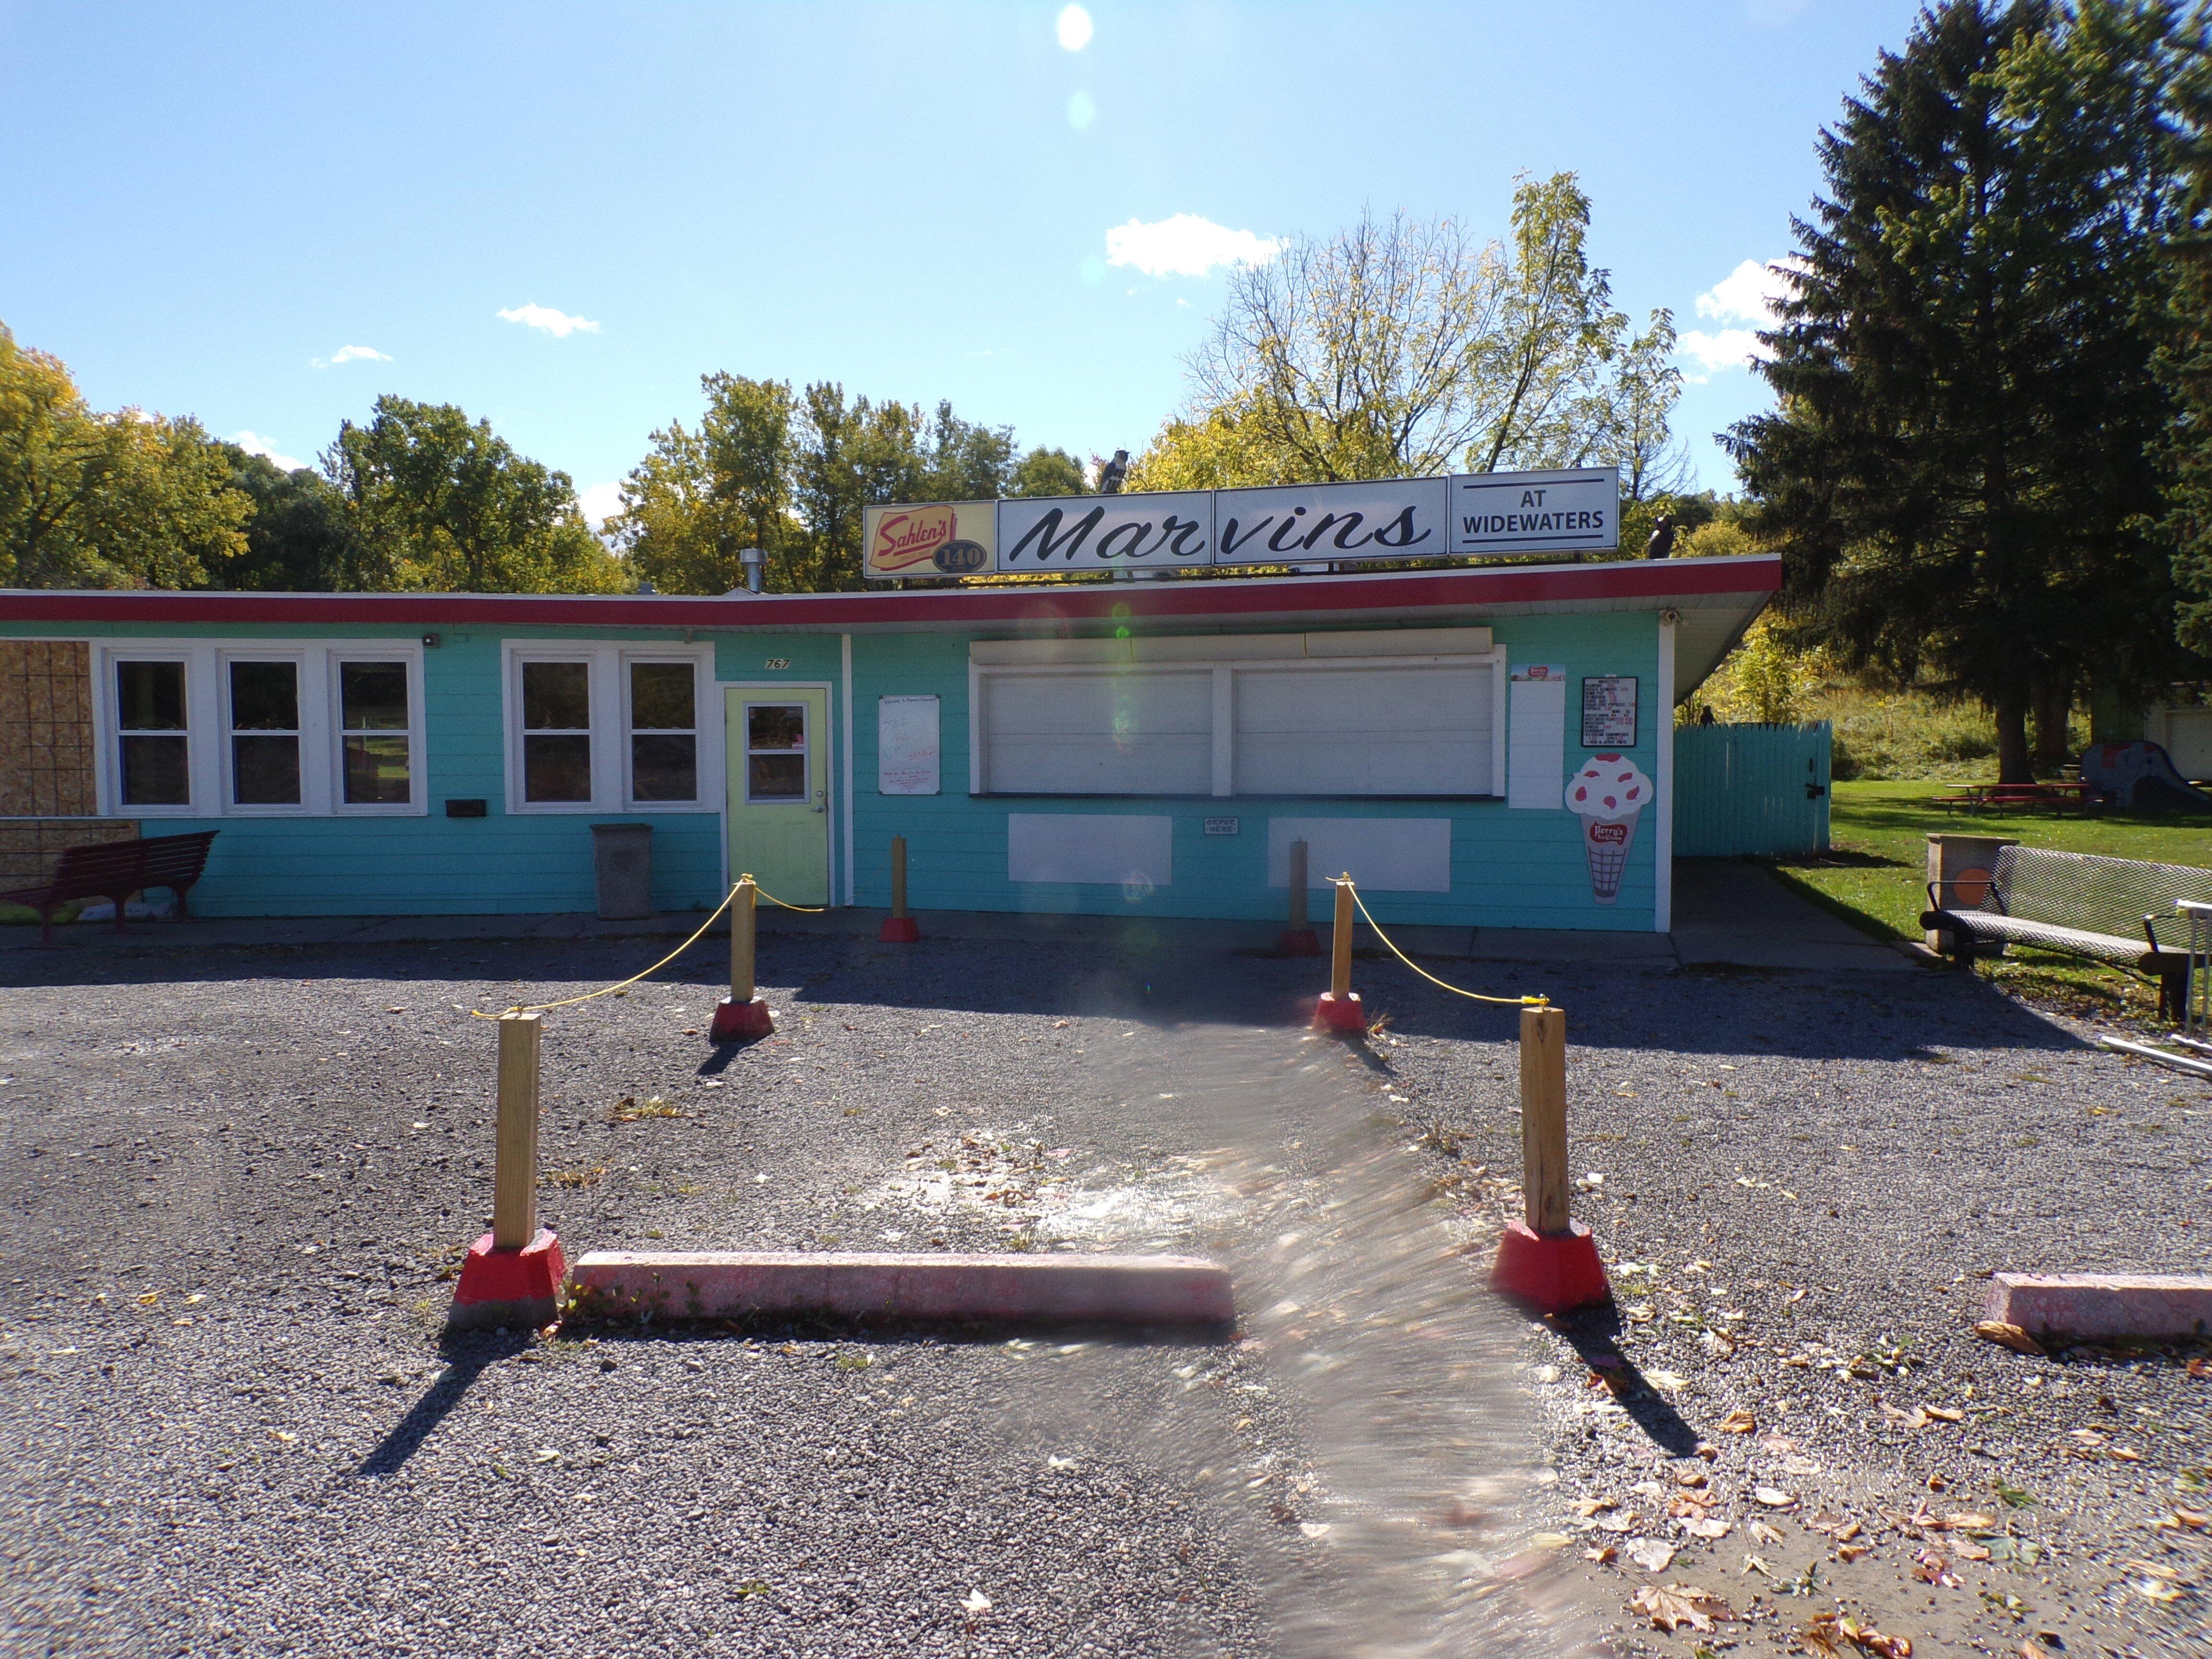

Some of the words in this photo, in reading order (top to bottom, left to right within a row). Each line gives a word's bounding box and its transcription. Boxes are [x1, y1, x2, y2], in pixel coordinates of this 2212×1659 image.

[1520, 489, 1546, 508] AT
[1463, 510, 1604, 534] WIDEWATERS
[878, 515, 947, 556] Sahlen's
[940, 548, 981, 566] 140
[766, 659, 790, 668] 767
[1594, 825, 1623, 837] Perry's
